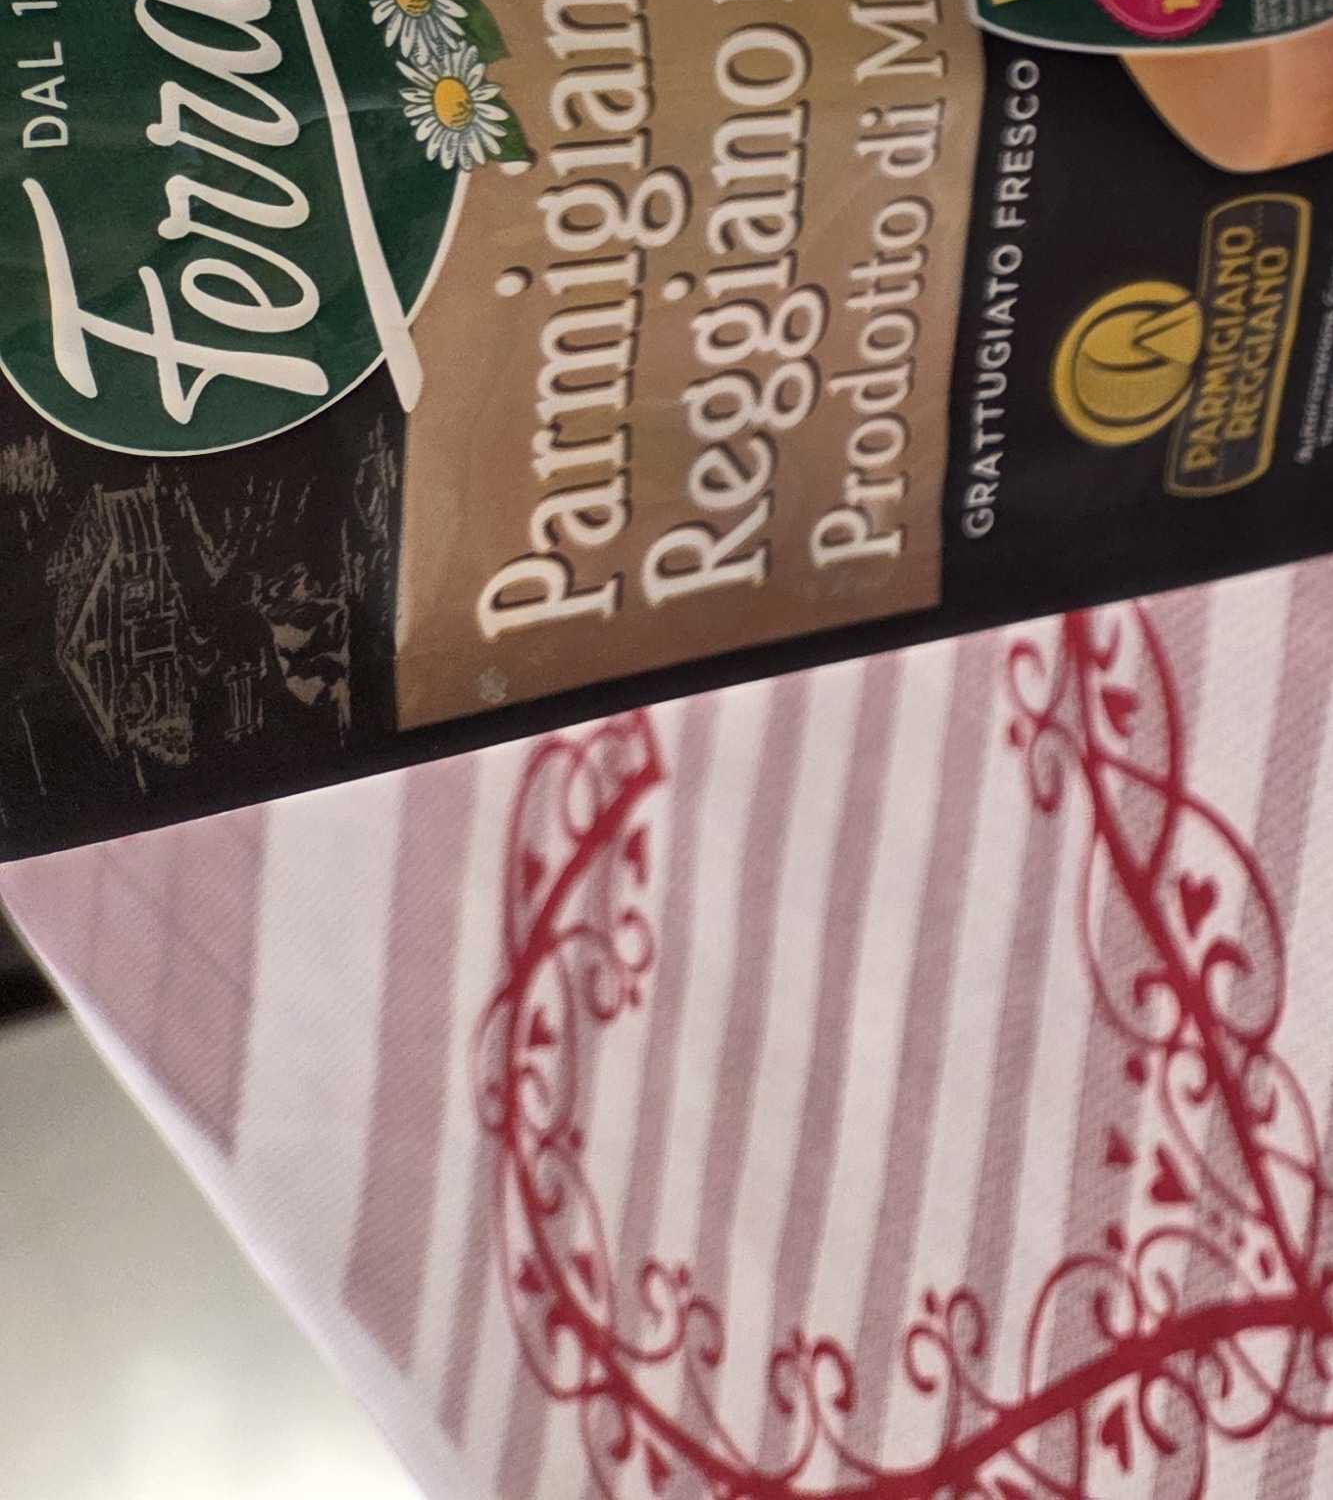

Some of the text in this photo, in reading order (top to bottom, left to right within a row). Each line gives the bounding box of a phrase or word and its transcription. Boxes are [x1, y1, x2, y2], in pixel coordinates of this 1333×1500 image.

[17, 41, 69, 149] DAL
[856, 99, 942, 178] di
[641, 25, 825, 607] Reggiano
[810, 199, 929, 568] Prodotto
[962, 59, 1040, 539] GRATTUGIATO FRESCO
[1184, 225, 1257, 471] PARMIGIANO
[1223, 245, 1290, 441] REGGIANO
